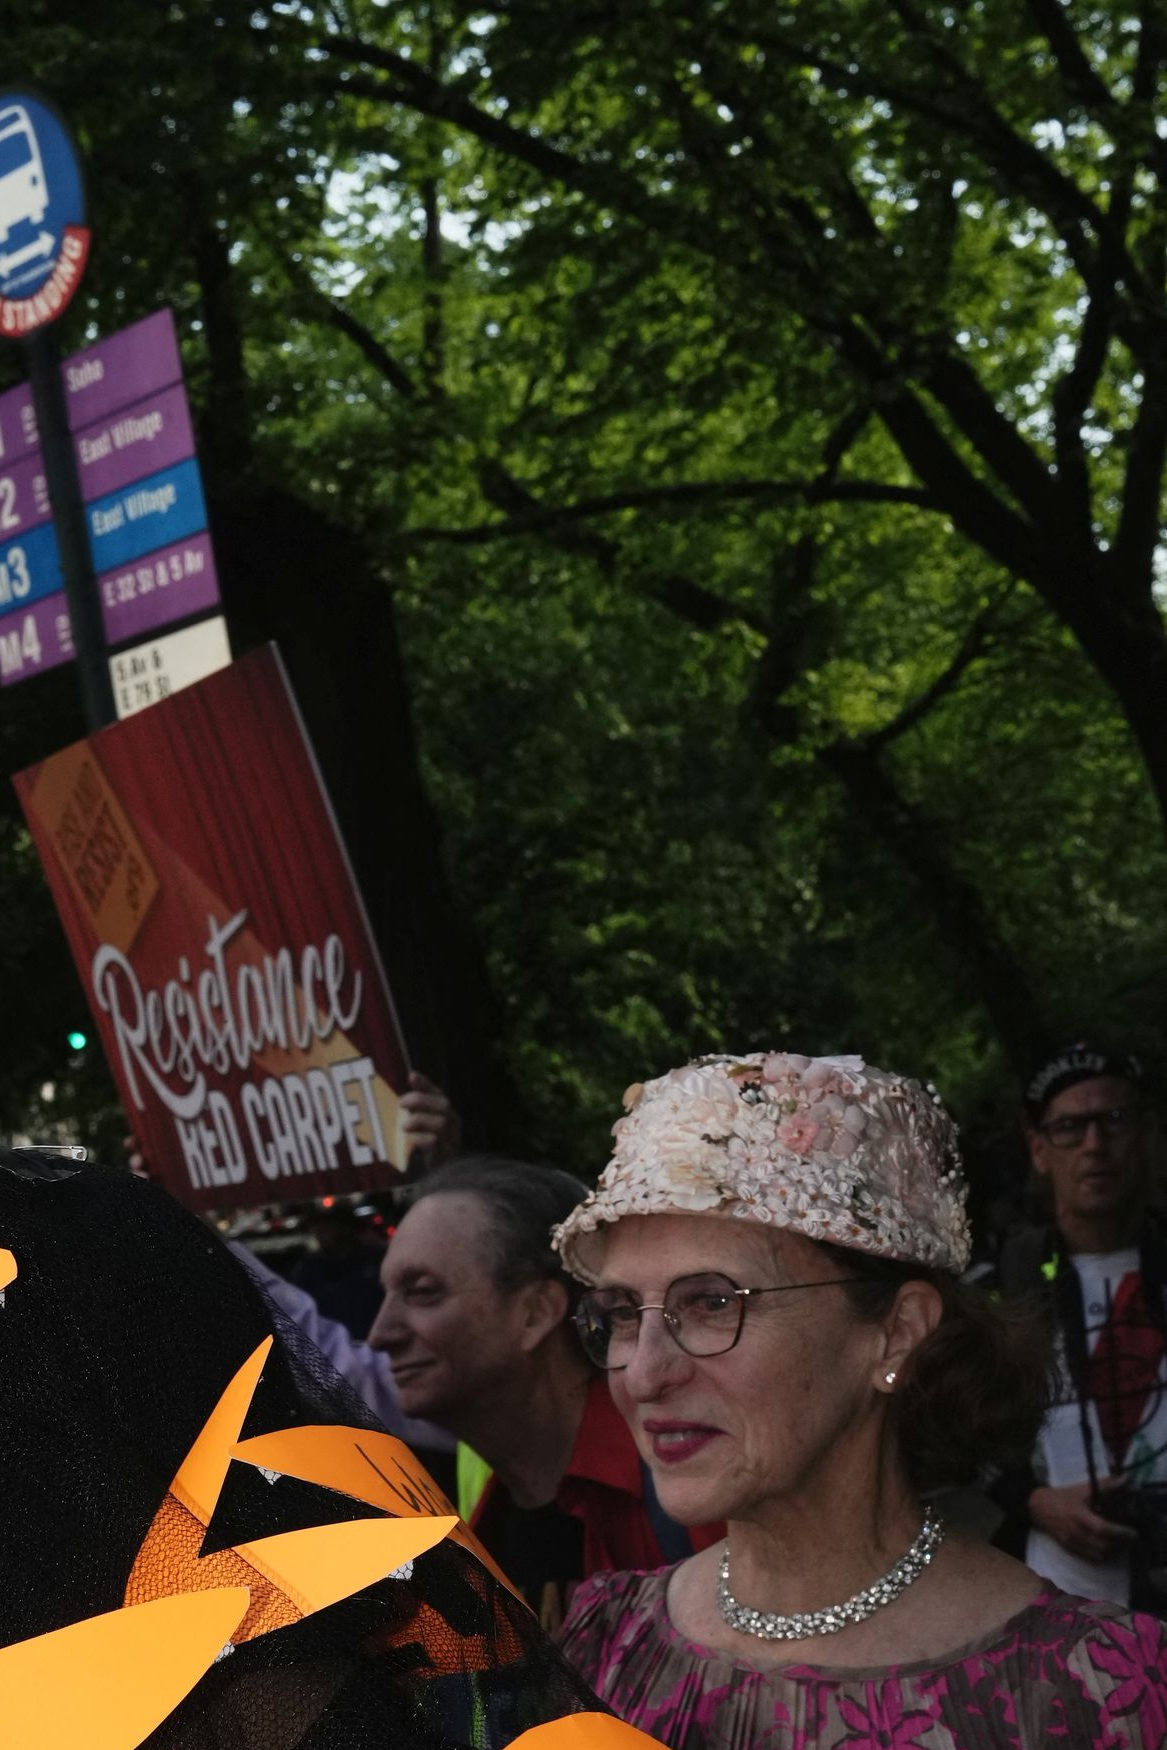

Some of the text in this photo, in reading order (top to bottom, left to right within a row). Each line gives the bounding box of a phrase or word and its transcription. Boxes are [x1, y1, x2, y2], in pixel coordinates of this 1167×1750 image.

[2, 235, 84, 332] STANDING
[79, 411, 163, 465] East Village
[92, 483, 177, 537] East Village
[102, 581, 116, 608] E
[136, 565, 154, 595] St
[155, 560, 168, 587] &
[169, 554, 182, 581] 5
[183, 544, 204, 575] Av
[93, 909, 361, 1119] Resistance
[175, 1057, 388, 1190] RED CARPET
